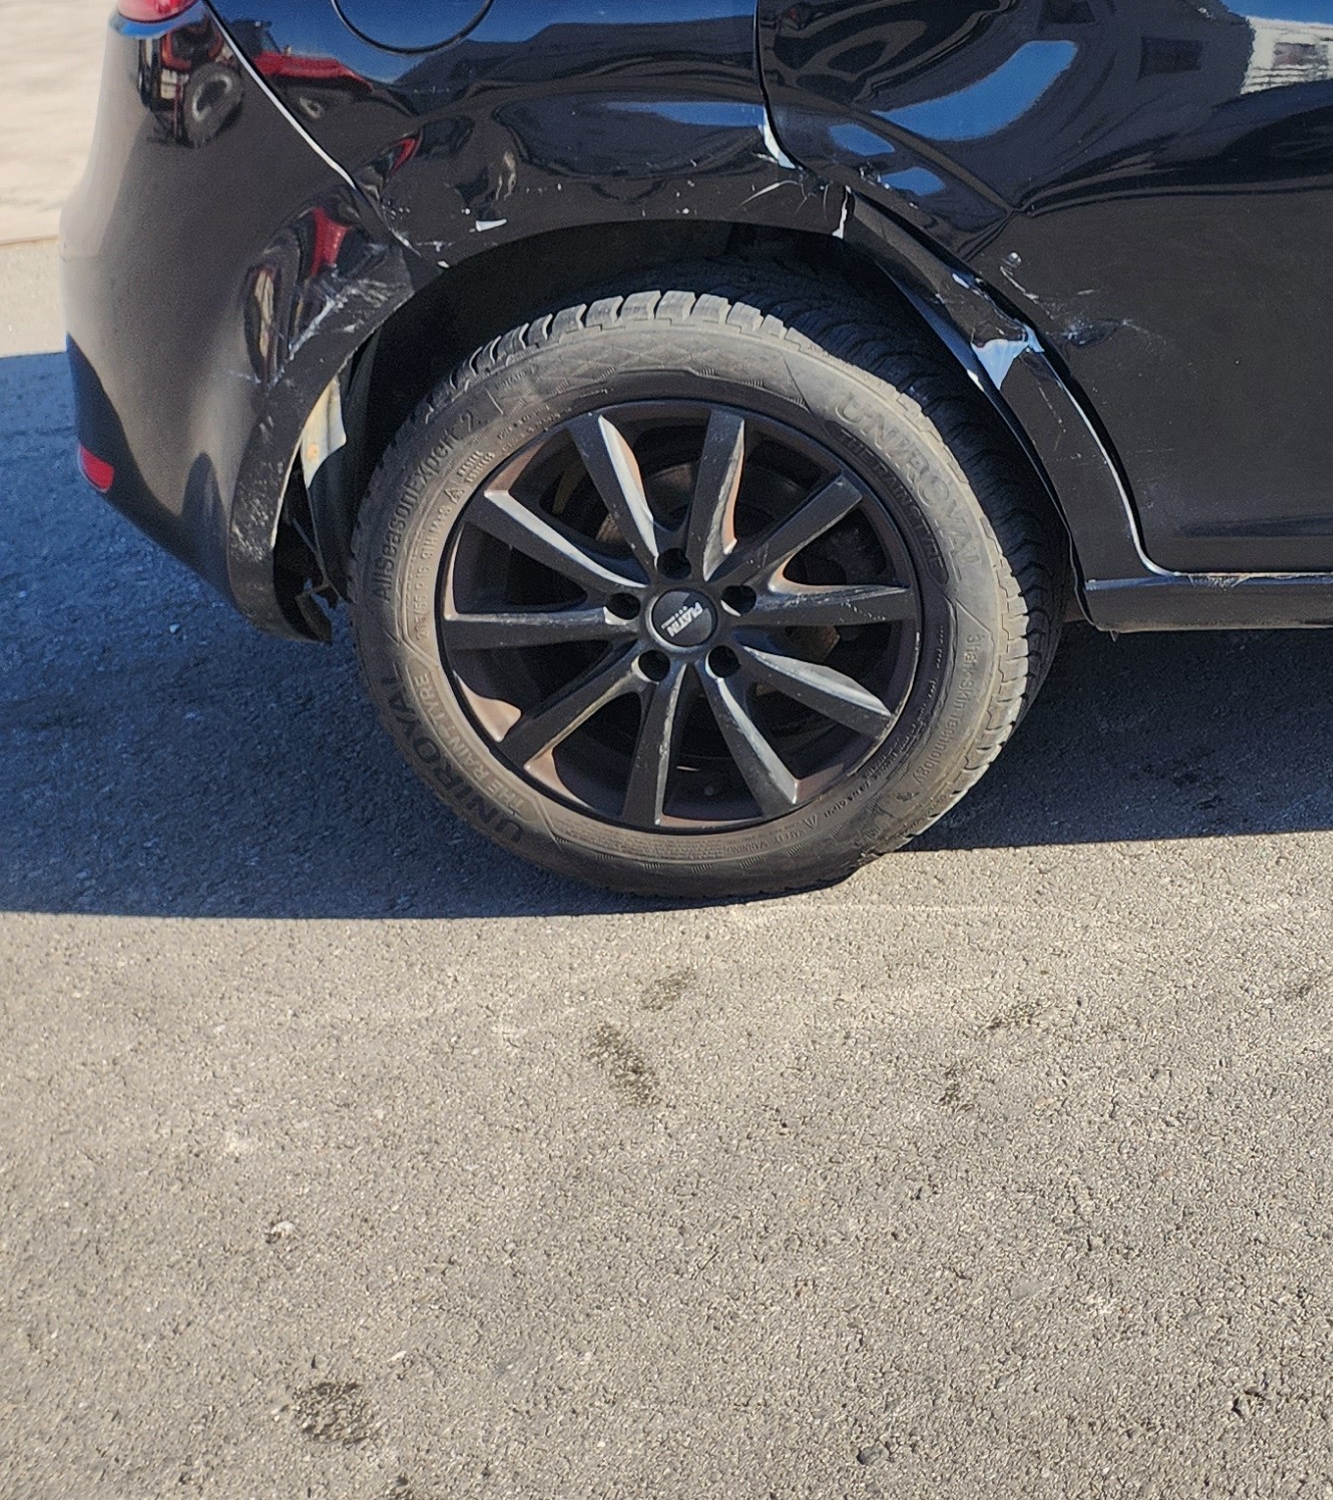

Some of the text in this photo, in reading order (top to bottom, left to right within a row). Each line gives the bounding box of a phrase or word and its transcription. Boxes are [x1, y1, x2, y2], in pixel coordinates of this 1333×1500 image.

[371, 426, 464, 602] AllSeasonExpert
[833, 391, 982, 583] UNIROYAL
[666, 601, 704, 637] PLATIN
[382, 663, 523, 843] UNIROYAL
[413, 672, 525, 811] THE RAIN TYRE
